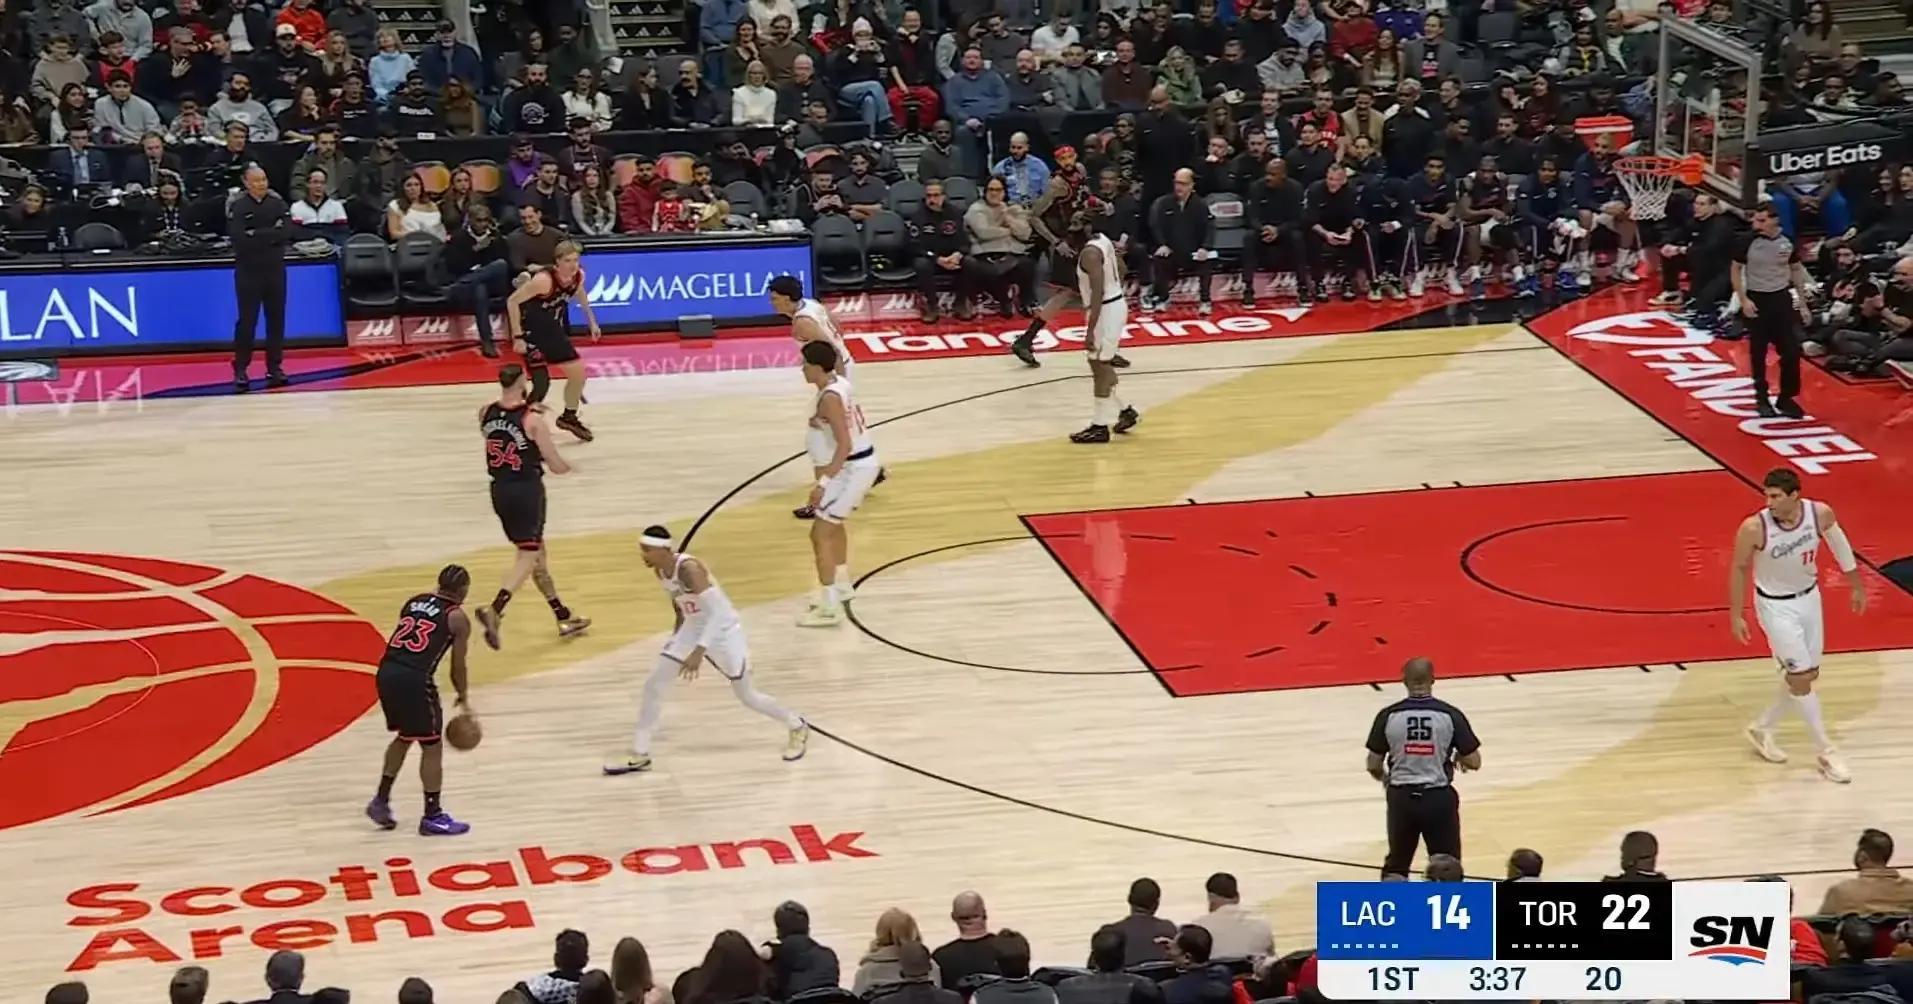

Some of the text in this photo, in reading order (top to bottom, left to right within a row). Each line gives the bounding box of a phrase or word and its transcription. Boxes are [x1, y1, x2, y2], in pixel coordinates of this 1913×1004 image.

[1770, 143, 1882, 173] Uber Eats
[638, 270, 804, 301] MAGELLA
[0, 286, 139, 341] LAN
[843, 316, 1273, 353] Tangerine
[1627, 346, 1878, 475] FANDUEL
[486, 439, 523, 471] 54
[390, 616, 437, 653] 23
[1406, 716, 1433, 741] 25
[66, 824, 882, 927] Scotiabank
[64, 900, 535, 972] Arena
